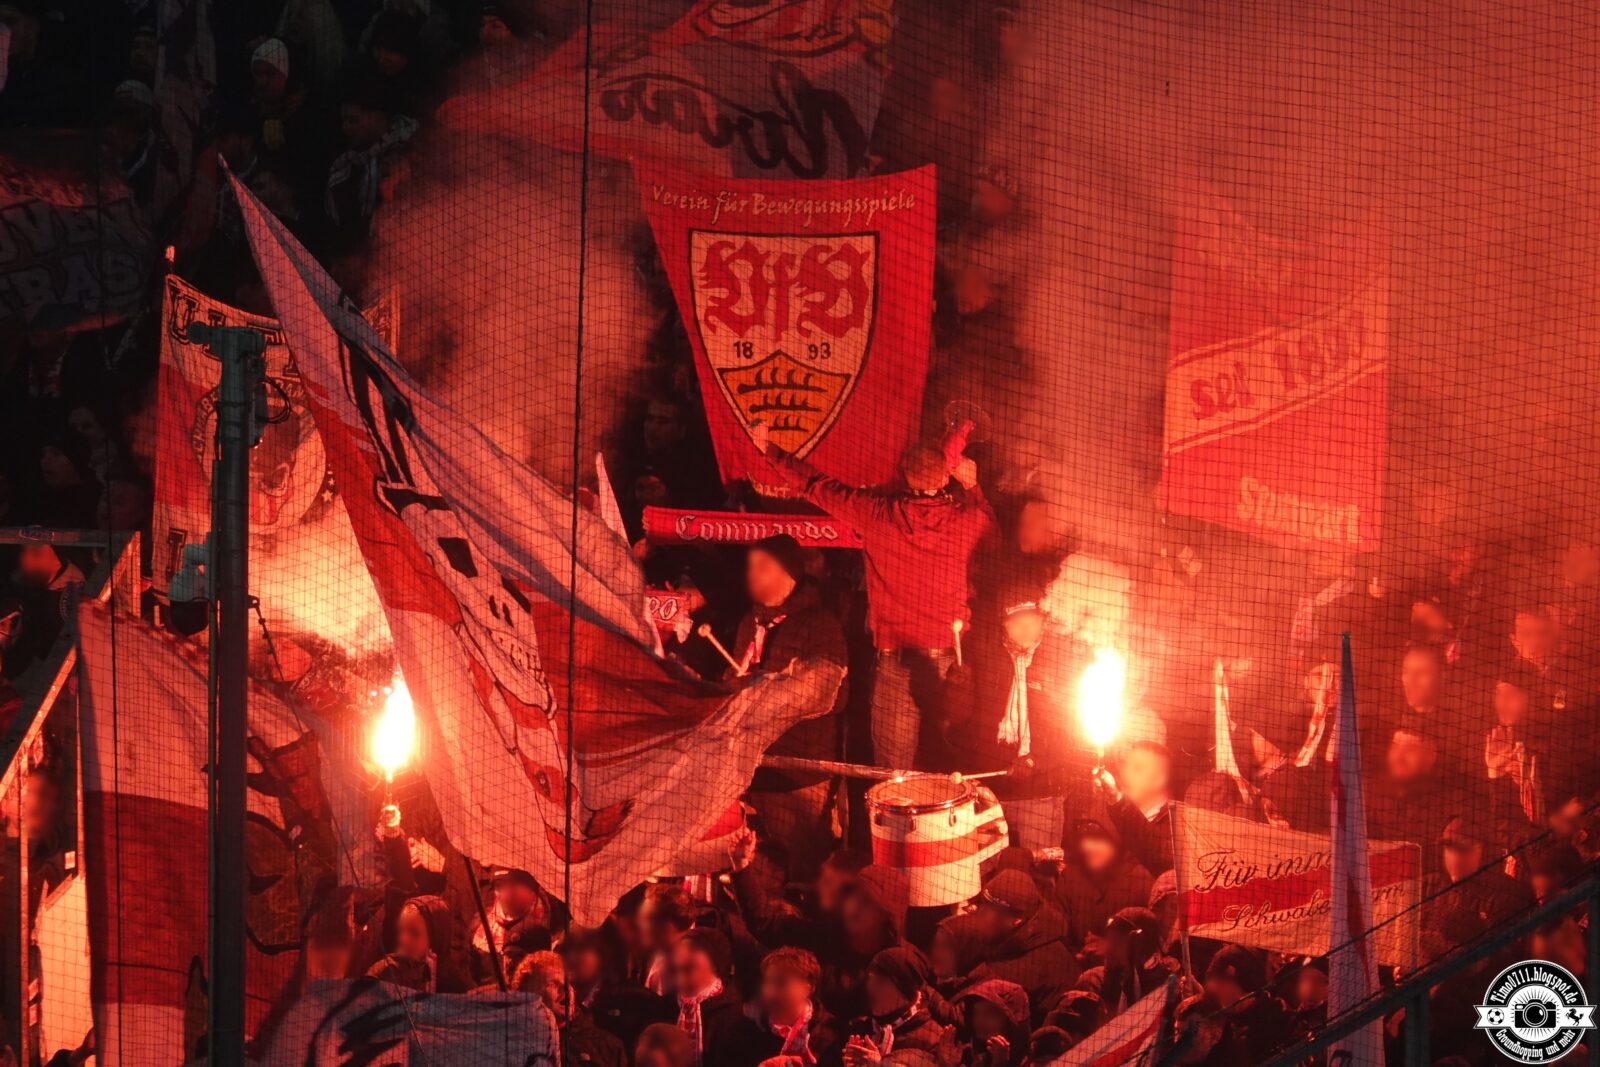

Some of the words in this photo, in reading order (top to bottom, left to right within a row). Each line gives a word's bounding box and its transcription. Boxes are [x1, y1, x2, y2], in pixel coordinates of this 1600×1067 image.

[652, 184, 711, 211] Verein
[711, 190, 748, 225] für
[751, 187, 916, 228] Bewegungsspiele
[733, 340, 754, 360] 18
[807, 342, 832, 361] 93
[675, 514, 838, 542] Commando
[1195, 848, 1258, 893] Für
